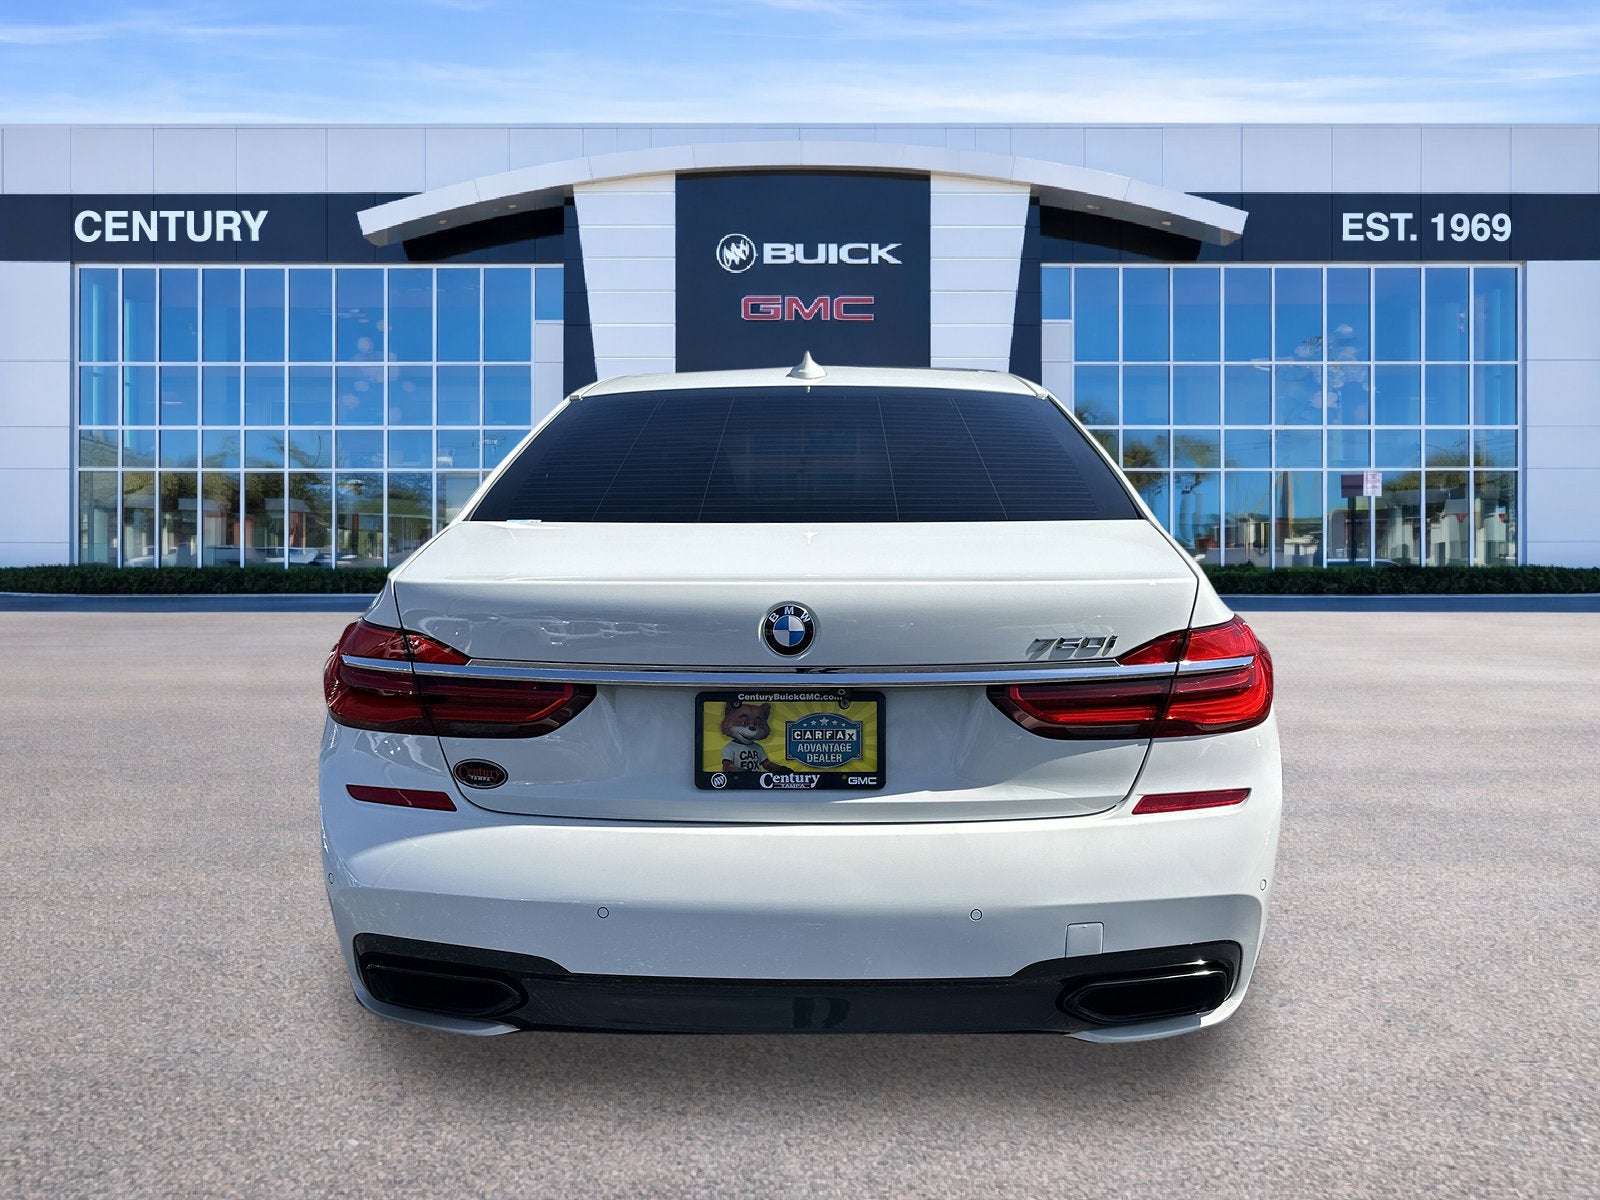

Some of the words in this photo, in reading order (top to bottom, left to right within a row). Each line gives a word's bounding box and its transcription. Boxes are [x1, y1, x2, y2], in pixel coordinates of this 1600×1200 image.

[74, 210, 269, 243] CENTURY
[1342, 212, 1418, 242] EST.
[1431, 212, 1512, 242] 1969
[763, 243, 903, 264] BUICK
[741, 295, 875, 321] GMC
[768, 605, 811, 623] BMW
[793, 730, 855, 740] CARFAX
[797, 743, 852, 752] ADVANTAGE
[740, 750, 759, 760] CAR
[806, 753, 843, 762] DEALER
[740, 760, 760, 770] FOX
[759, 772, 820, 789] Century
[848, 776, 877, 785] GMC
